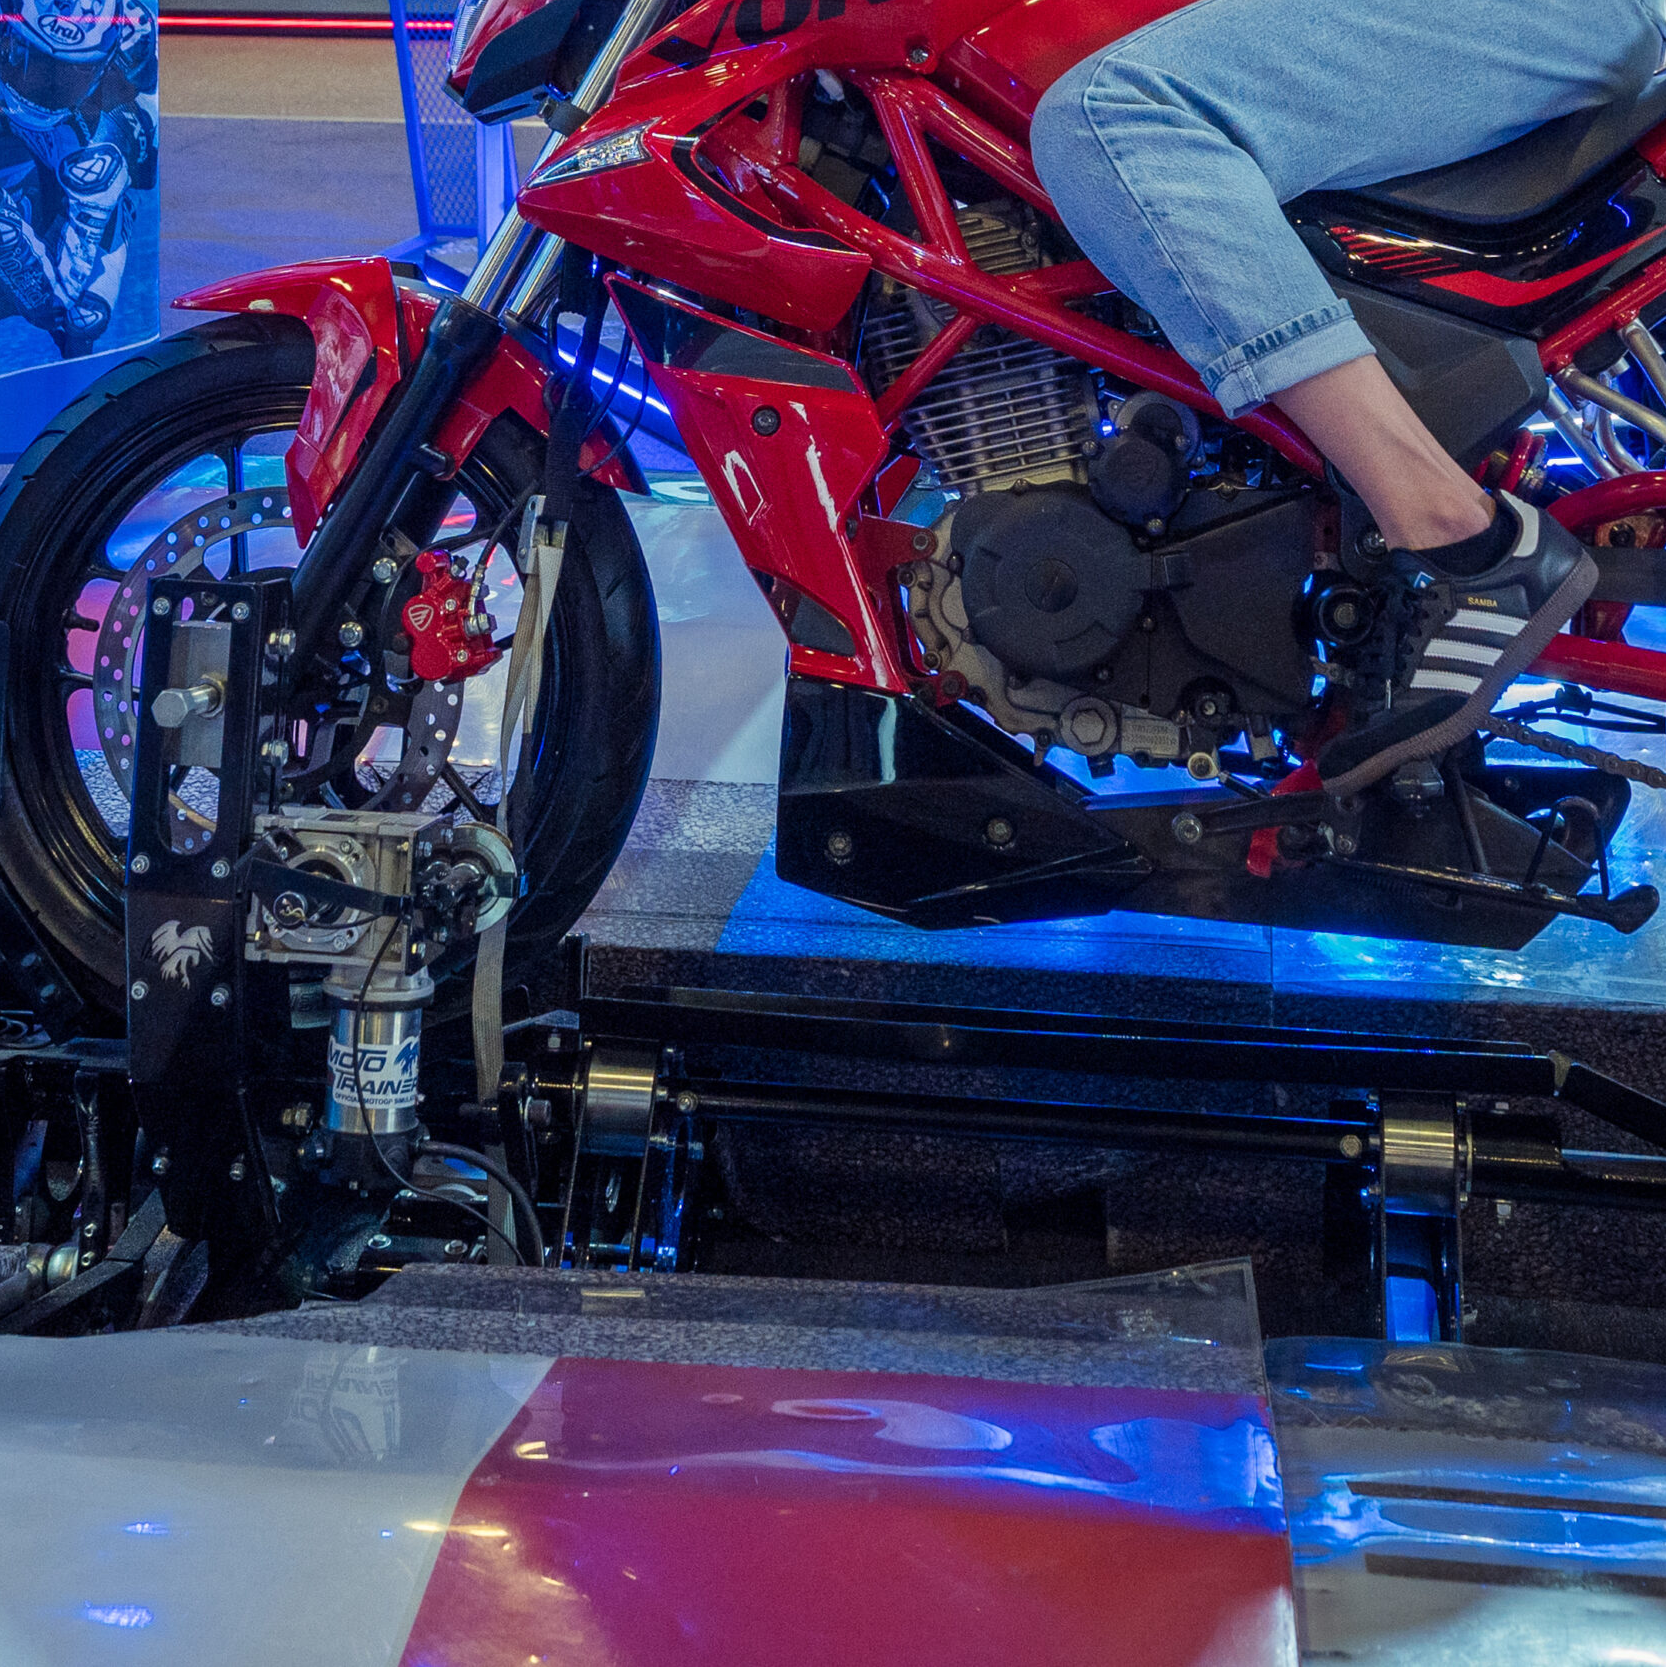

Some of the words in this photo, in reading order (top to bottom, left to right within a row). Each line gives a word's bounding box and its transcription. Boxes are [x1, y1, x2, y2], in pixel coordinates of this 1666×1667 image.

[45, 19, 79, 41] Arai
[1467, 596, 1498, 607] SAMBA
[329, 1041, 387, 1073] MOTO
